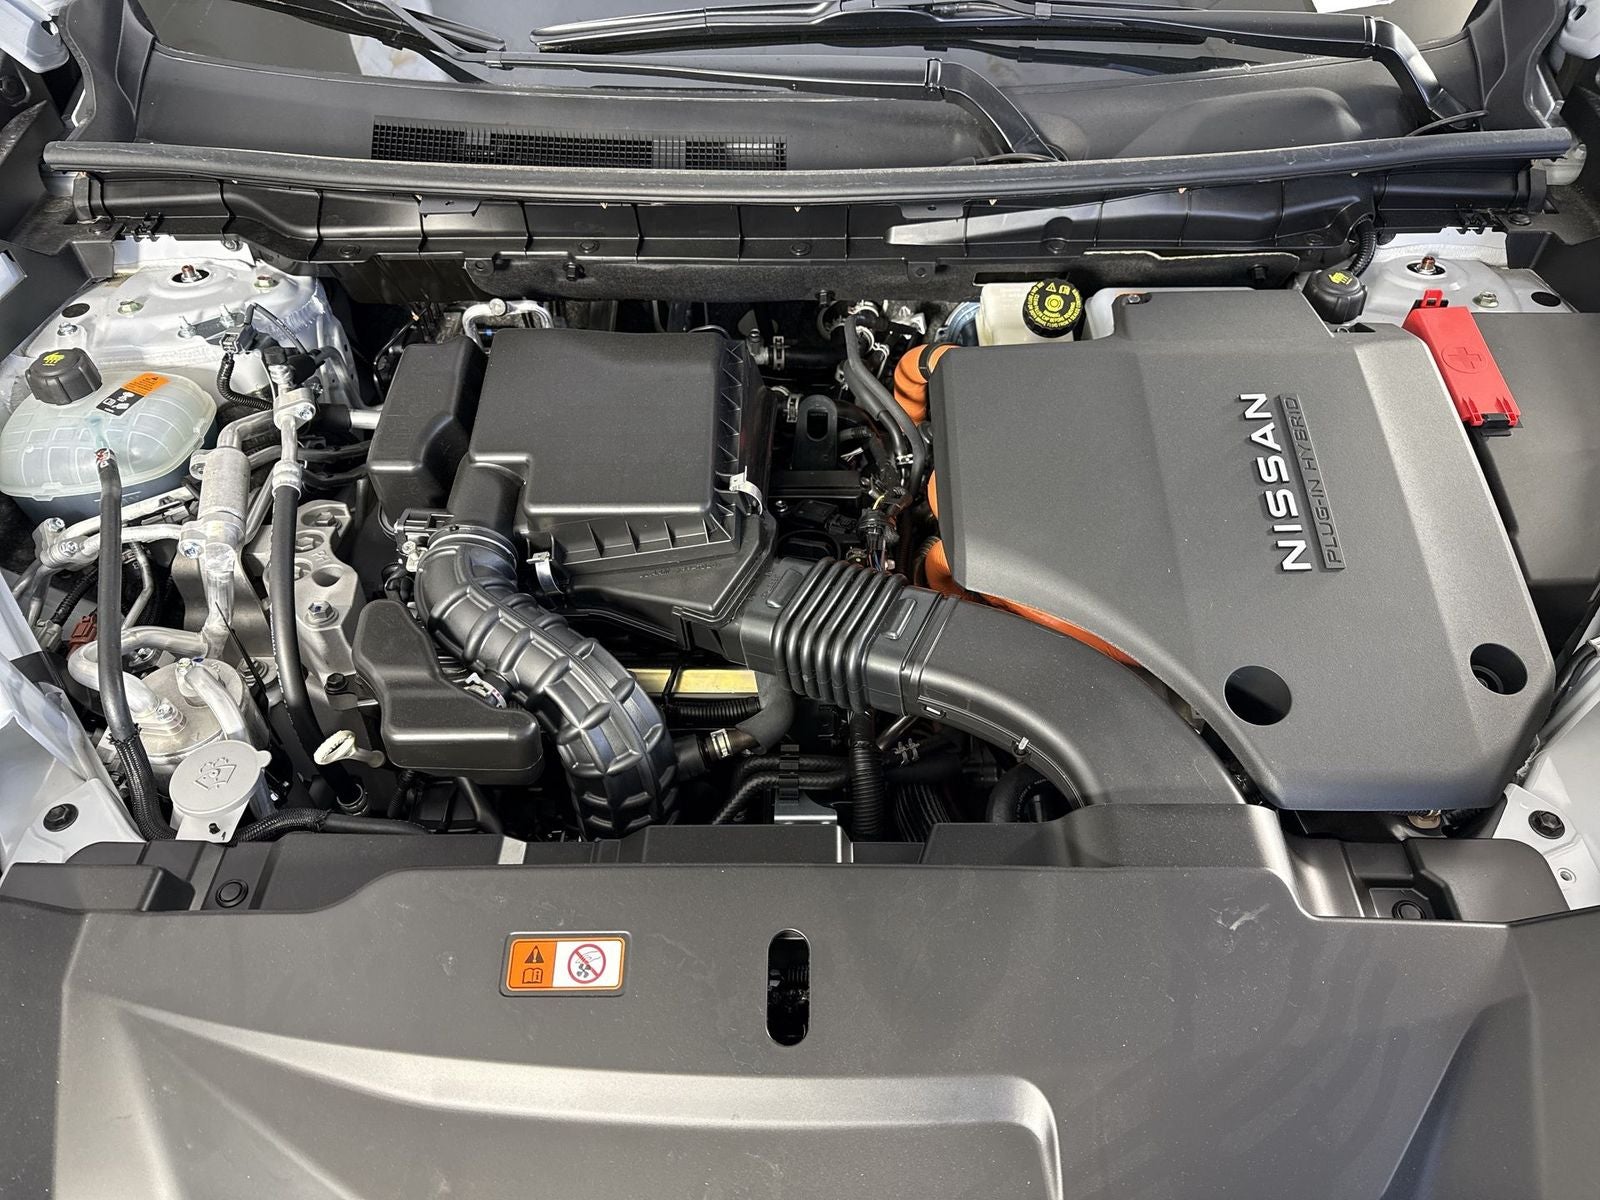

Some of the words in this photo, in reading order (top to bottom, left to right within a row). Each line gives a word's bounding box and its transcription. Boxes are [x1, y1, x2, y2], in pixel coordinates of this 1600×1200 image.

[1285, 397, 1317, 472] HYBRID
[1239, 393, 1313, 572] NISSAN
[1307, 479, 1342, 565] PLUG-IN
